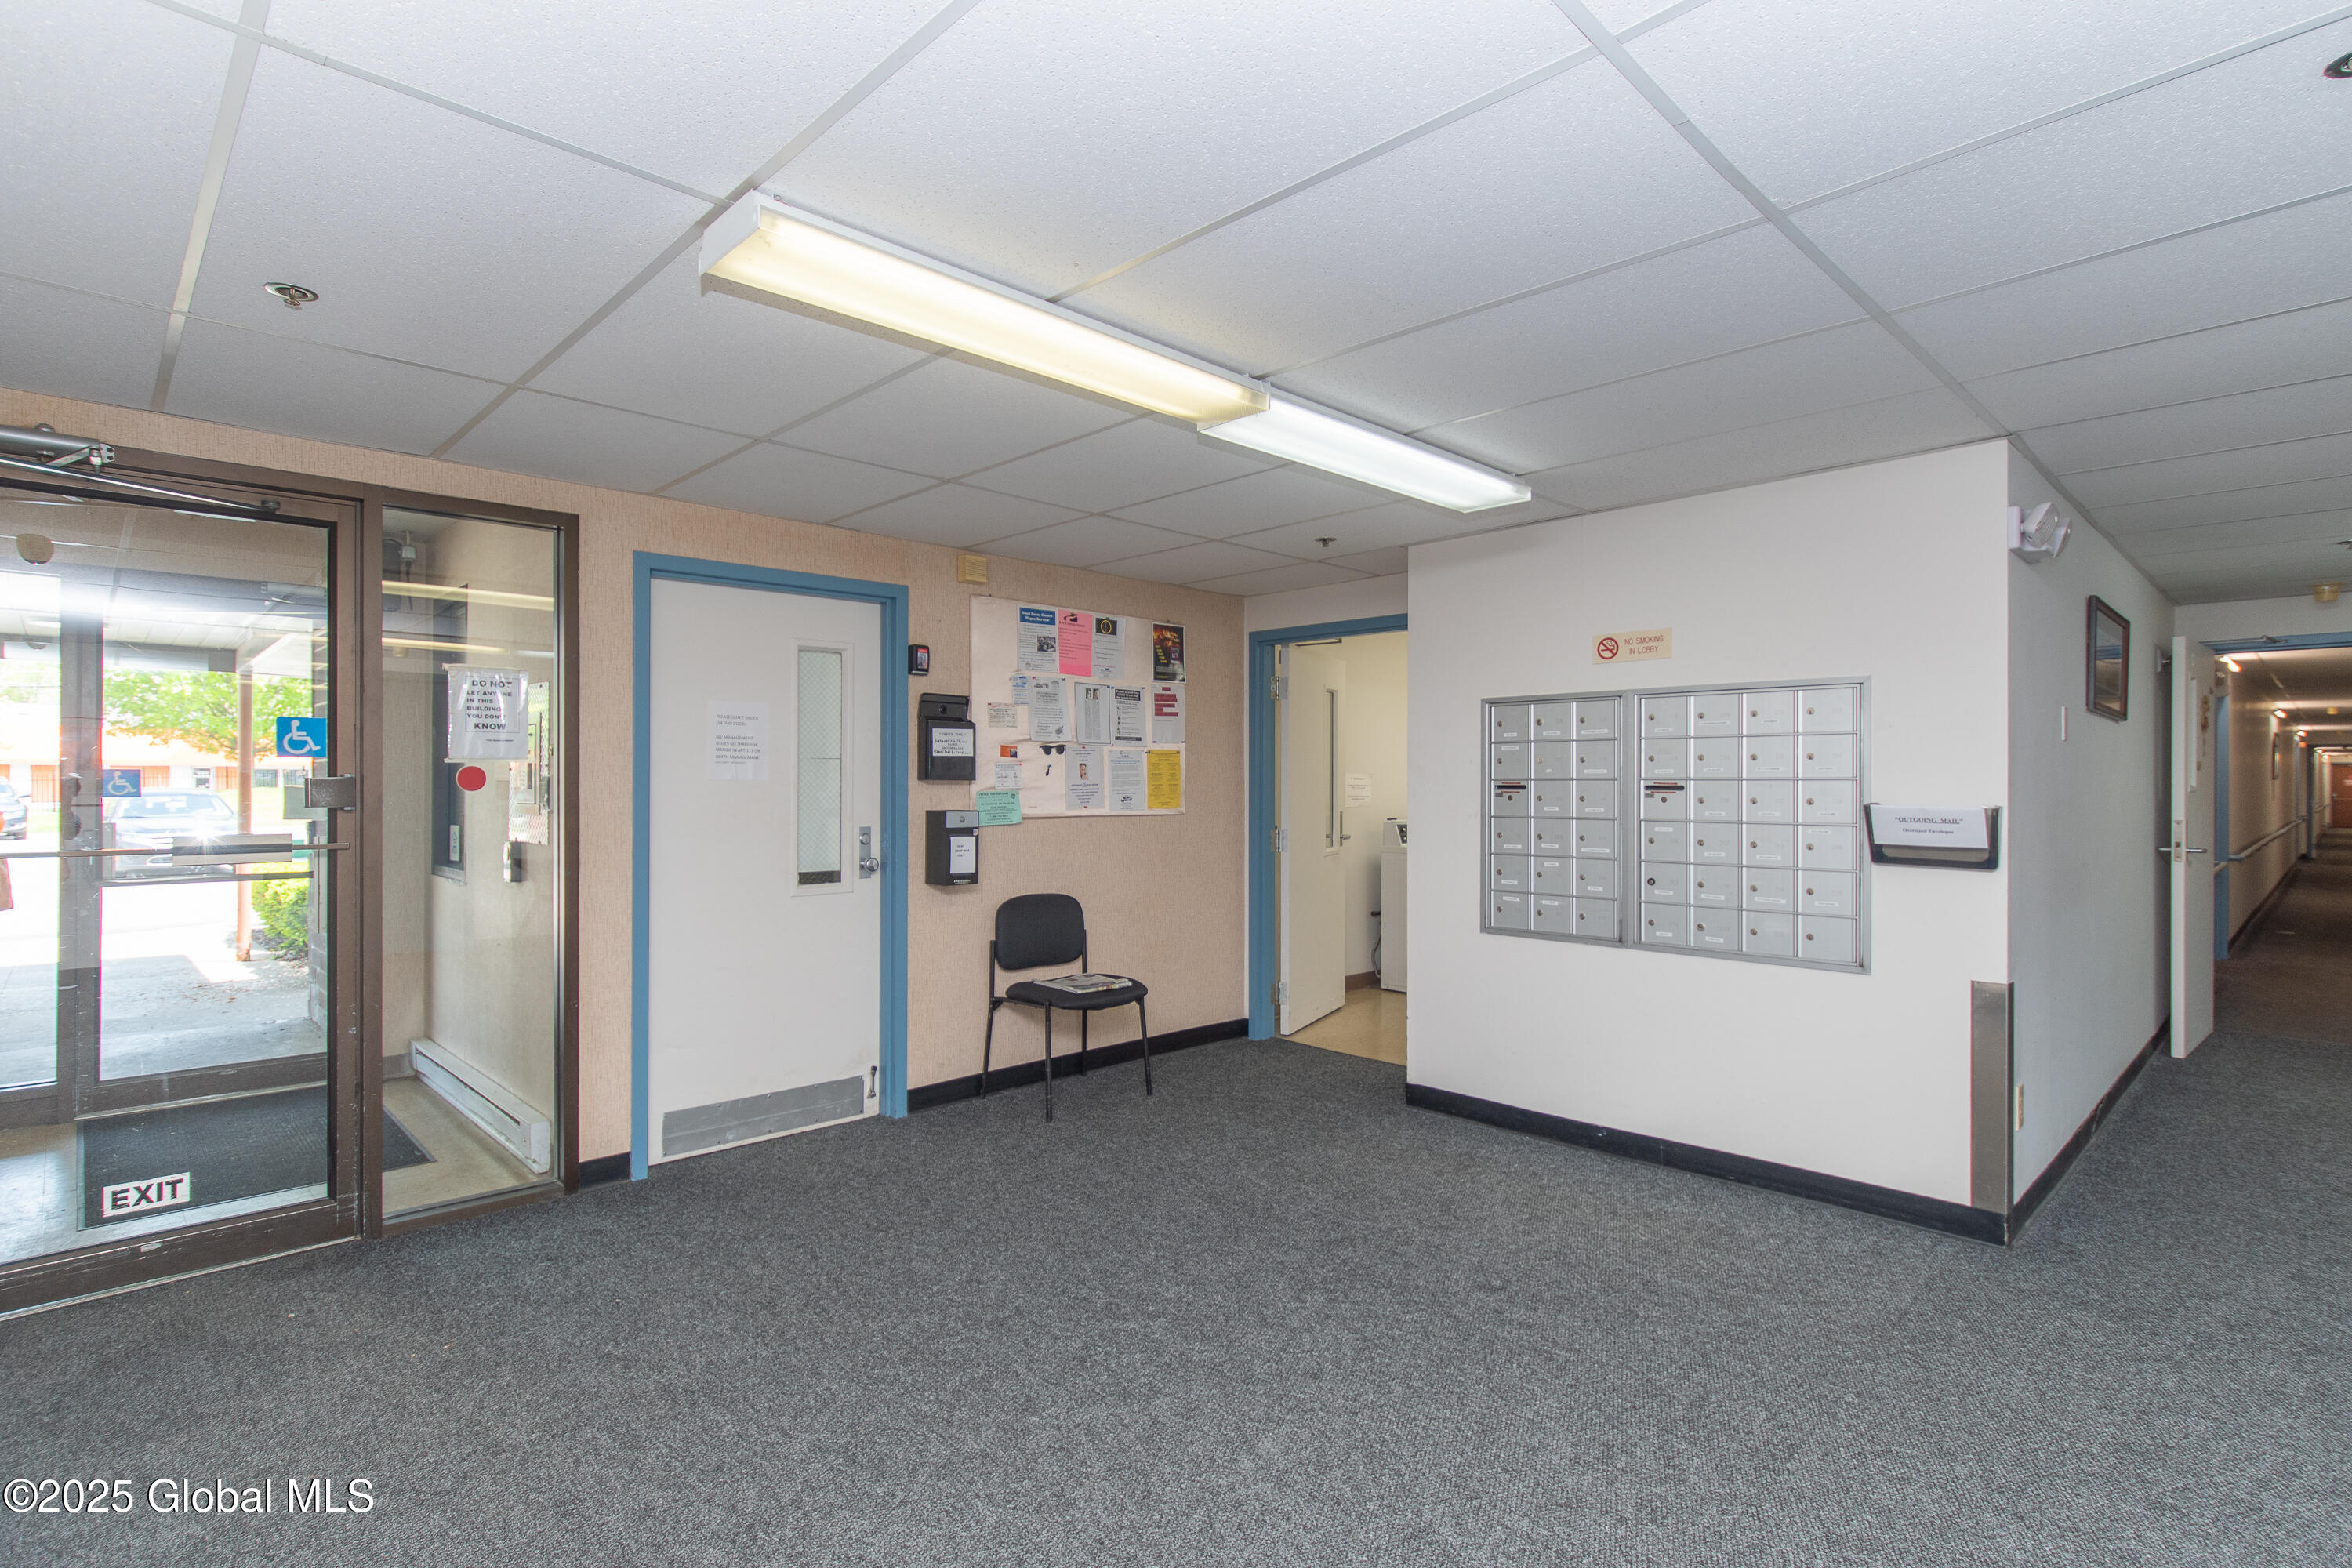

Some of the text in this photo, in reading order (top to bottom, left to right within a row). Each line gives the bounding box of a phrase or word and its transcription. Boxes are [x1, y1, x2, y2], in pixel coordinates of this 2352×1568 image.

[1636, 635, 1664, 644] SMOKING
[1637, 645, 1659, 654] LOBBY
[111, 1178, 183, 1209] EXIT
